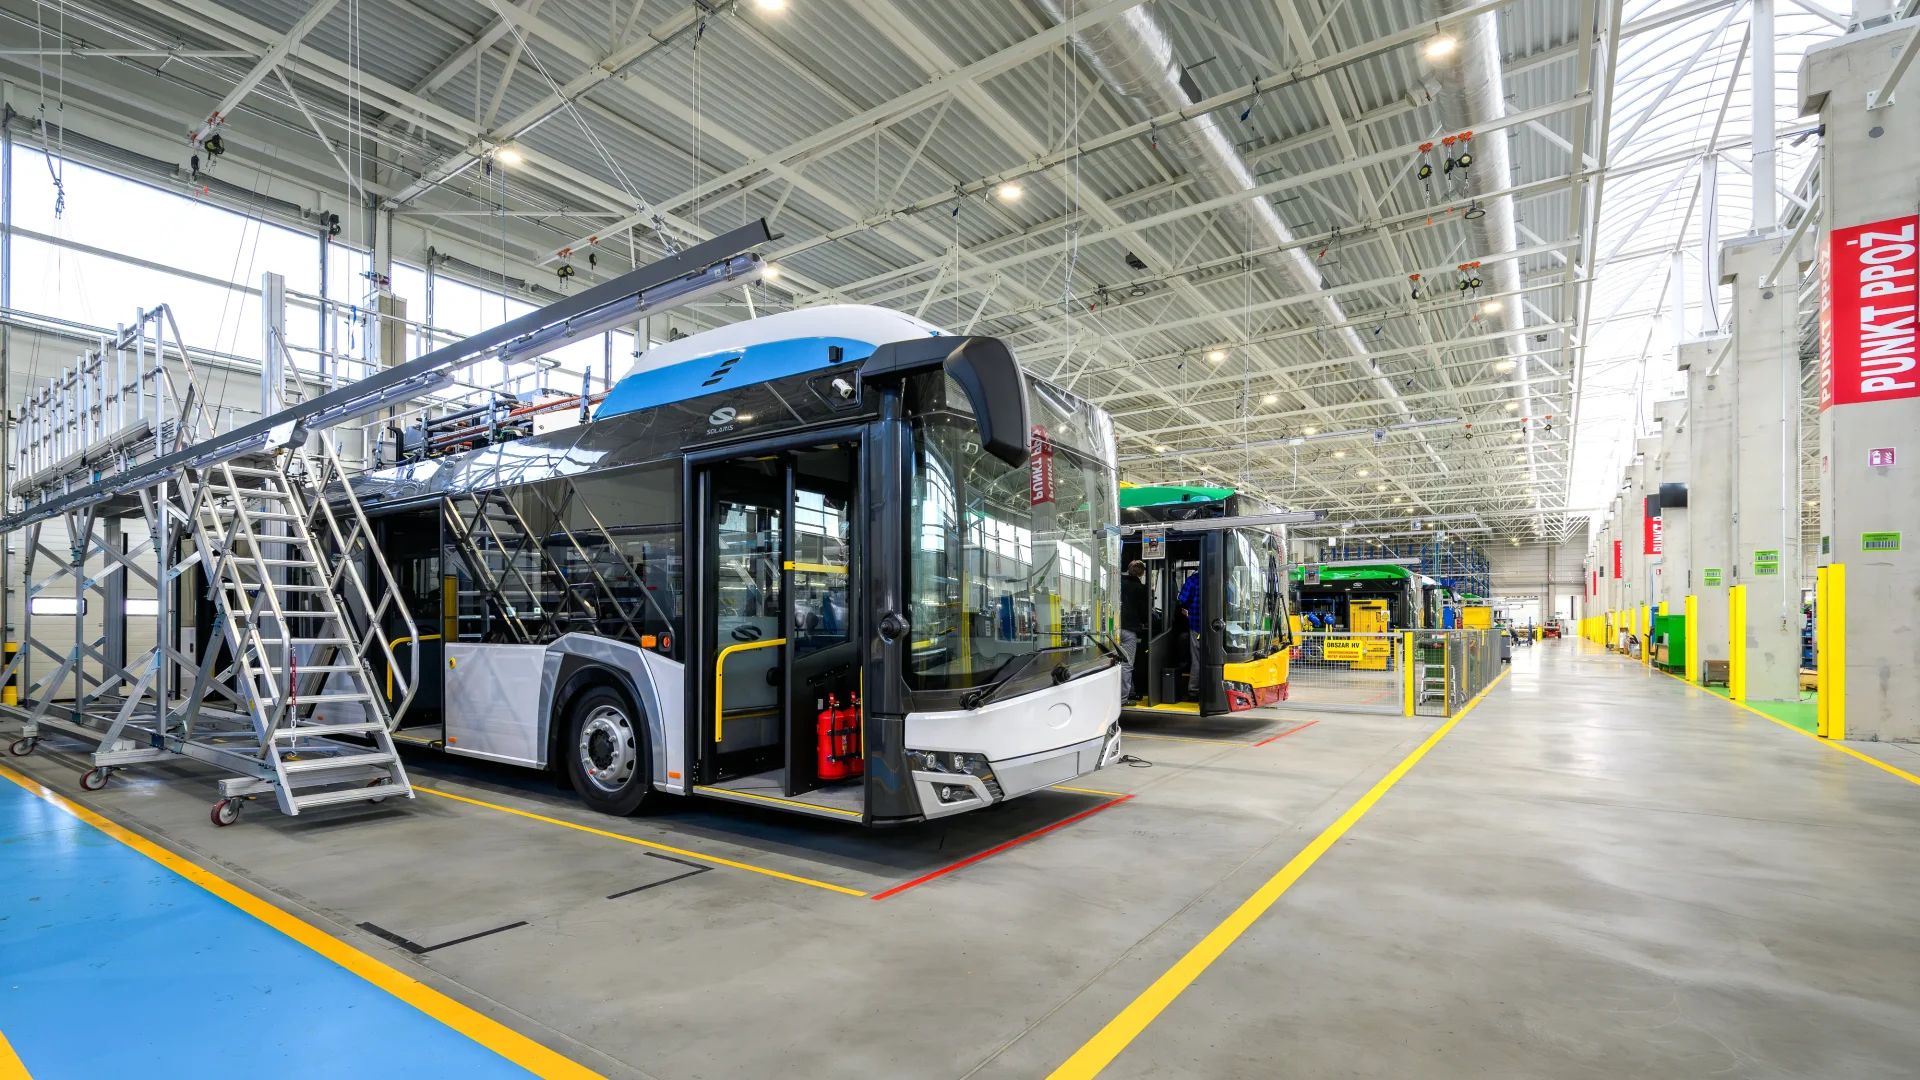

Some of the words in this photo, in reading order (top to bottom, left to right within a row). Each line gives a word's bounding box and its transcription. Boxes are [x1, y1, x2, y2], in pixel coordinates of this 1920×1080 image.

[1847, 223, 1916, 299] PPOŻ
[1821, 319, 1831, 404] PUNKT
[1860, 305, 1916, 395] PUNKT
[706, 425, 733, 435] SOLARIS
